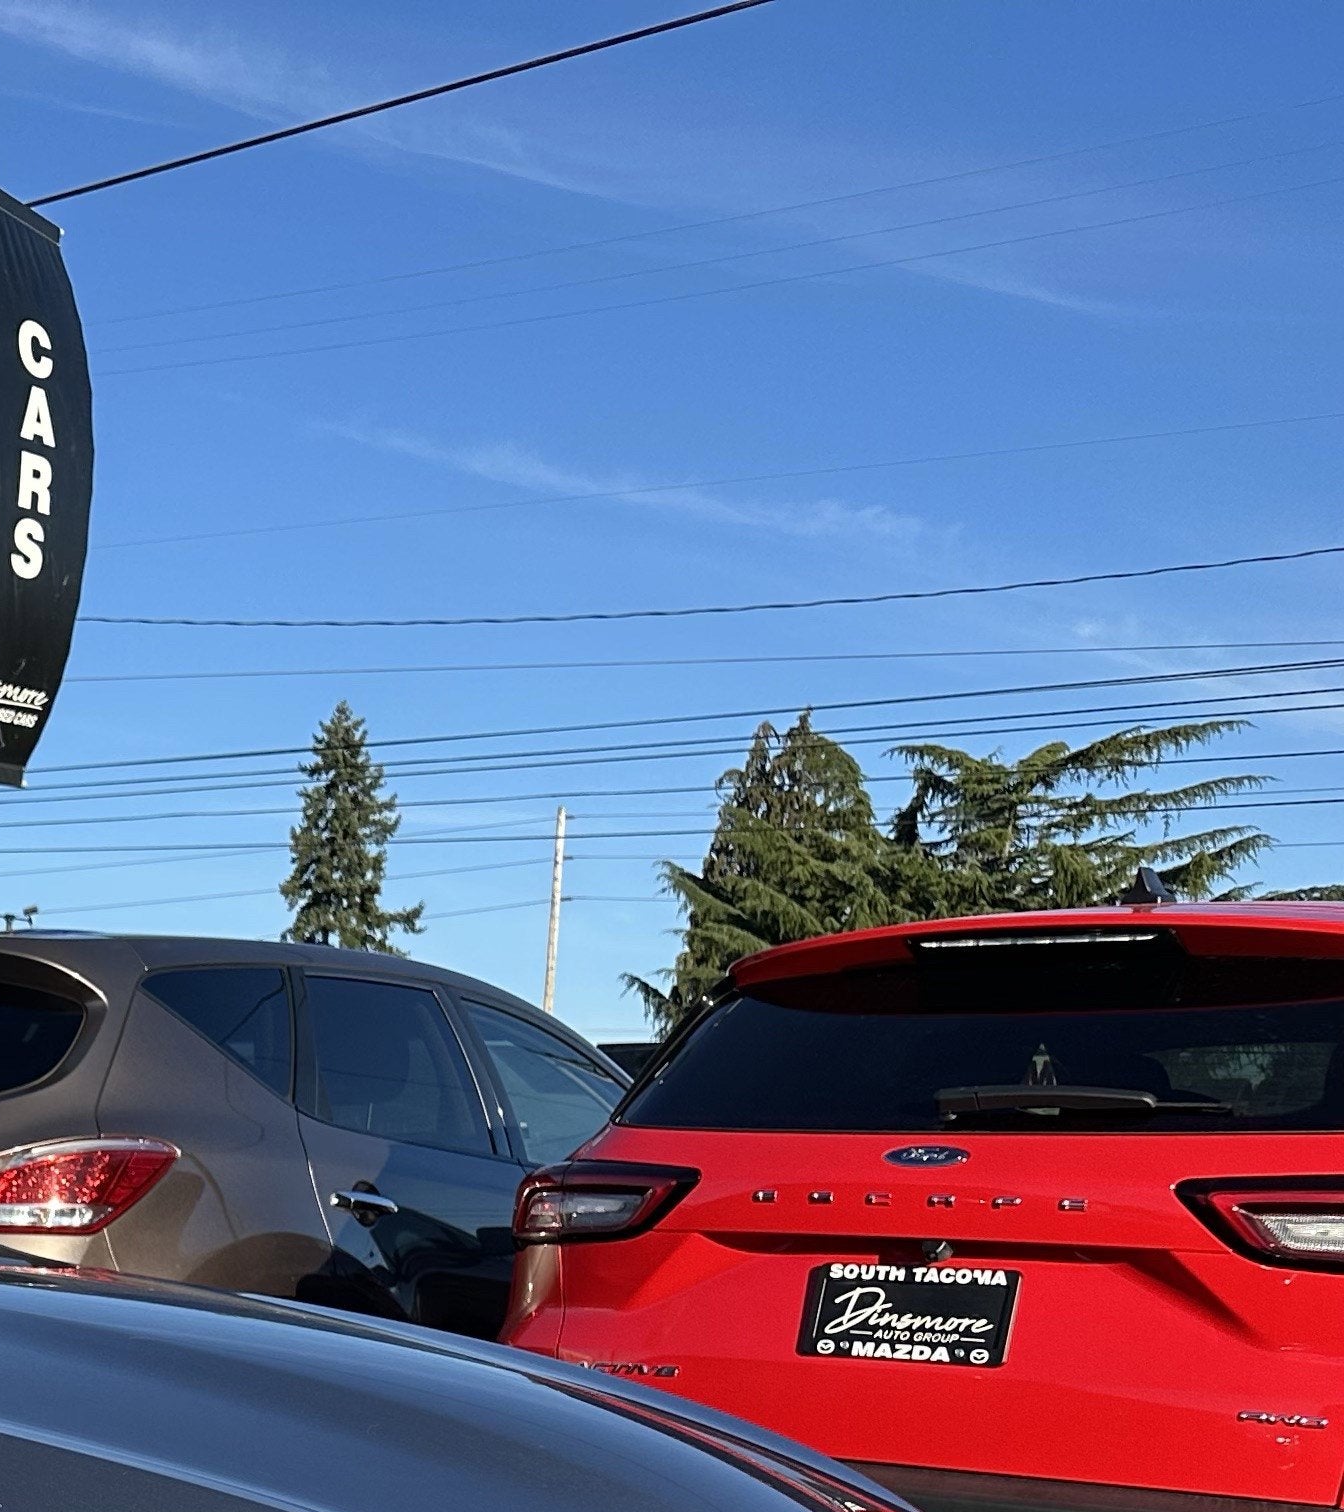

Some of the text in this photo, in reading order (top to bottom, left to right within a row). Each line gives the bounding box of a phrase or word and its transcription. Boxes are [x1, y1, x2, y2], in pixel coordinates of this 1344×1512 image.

[10, 319, 56, 580] CARS
[829, 1263, 1008, 1286] SOUTH TACOMA
[823, 1286, 995, 1335] Dinsmore
[873, 1329, 960, 1344] AUTO GROUP
[850, 1340, 952, 1362] MAZDA
